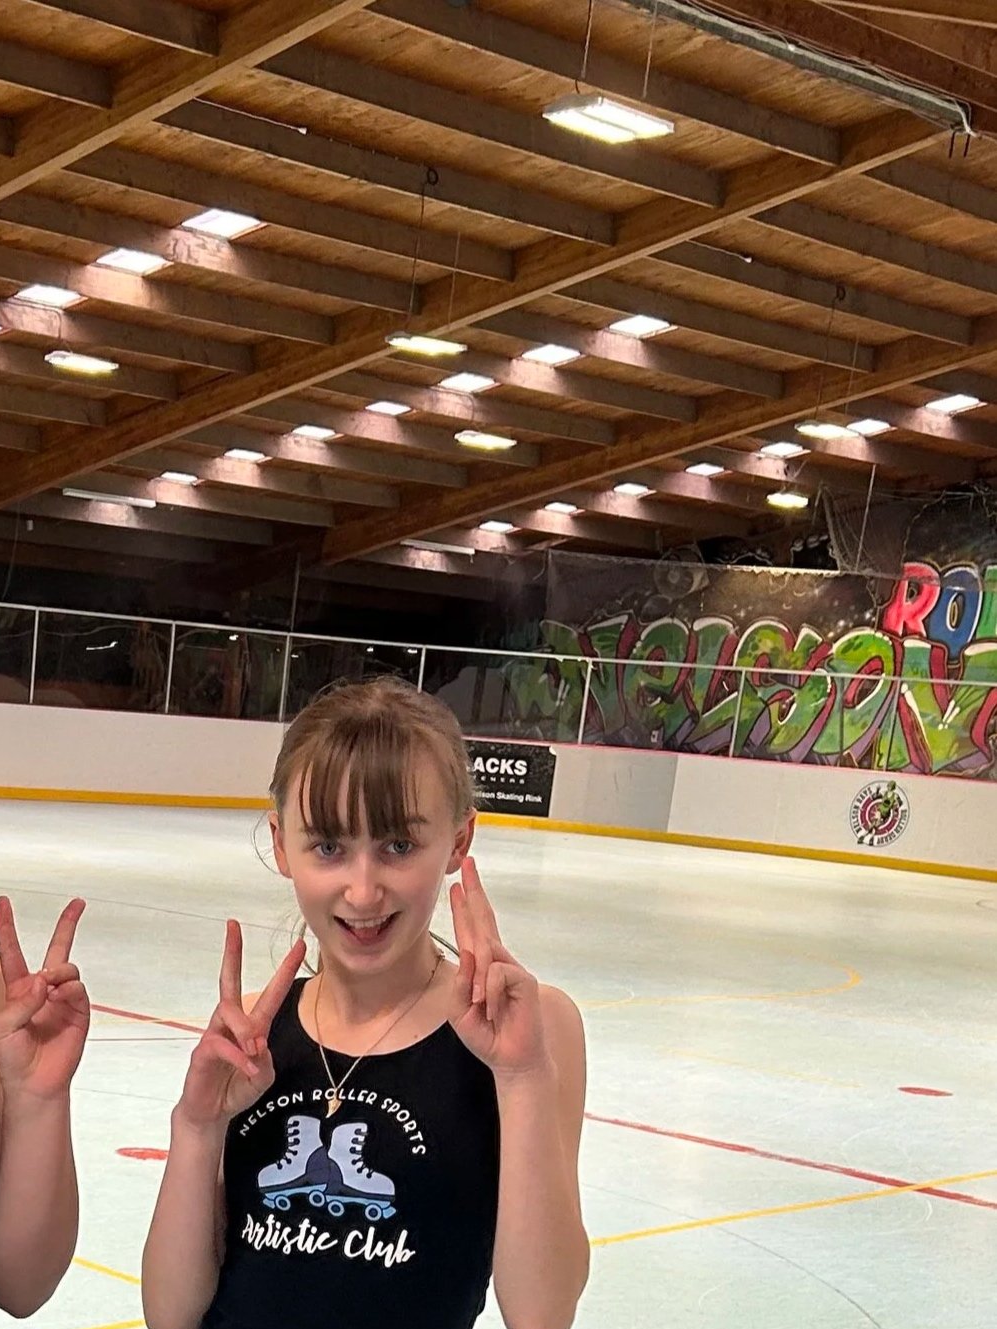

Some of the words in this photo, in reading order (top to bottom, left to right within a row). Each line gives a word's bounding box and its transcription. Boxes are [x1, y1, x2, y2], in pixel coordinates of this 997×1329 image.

[466, 756, 528, 776] ACKS
[496, 791, 524, 803] Skating
[525, 794, 543, 803] Rink
[239, 1091, 304, 1137] NELSON
[312, 1087, 378, 1105] ROLLER
[380, 1097, 427, 1155] SPORTS
[241, 1213, 339, 1255] Artistic
[343, 1226, 416, 1268] Club
